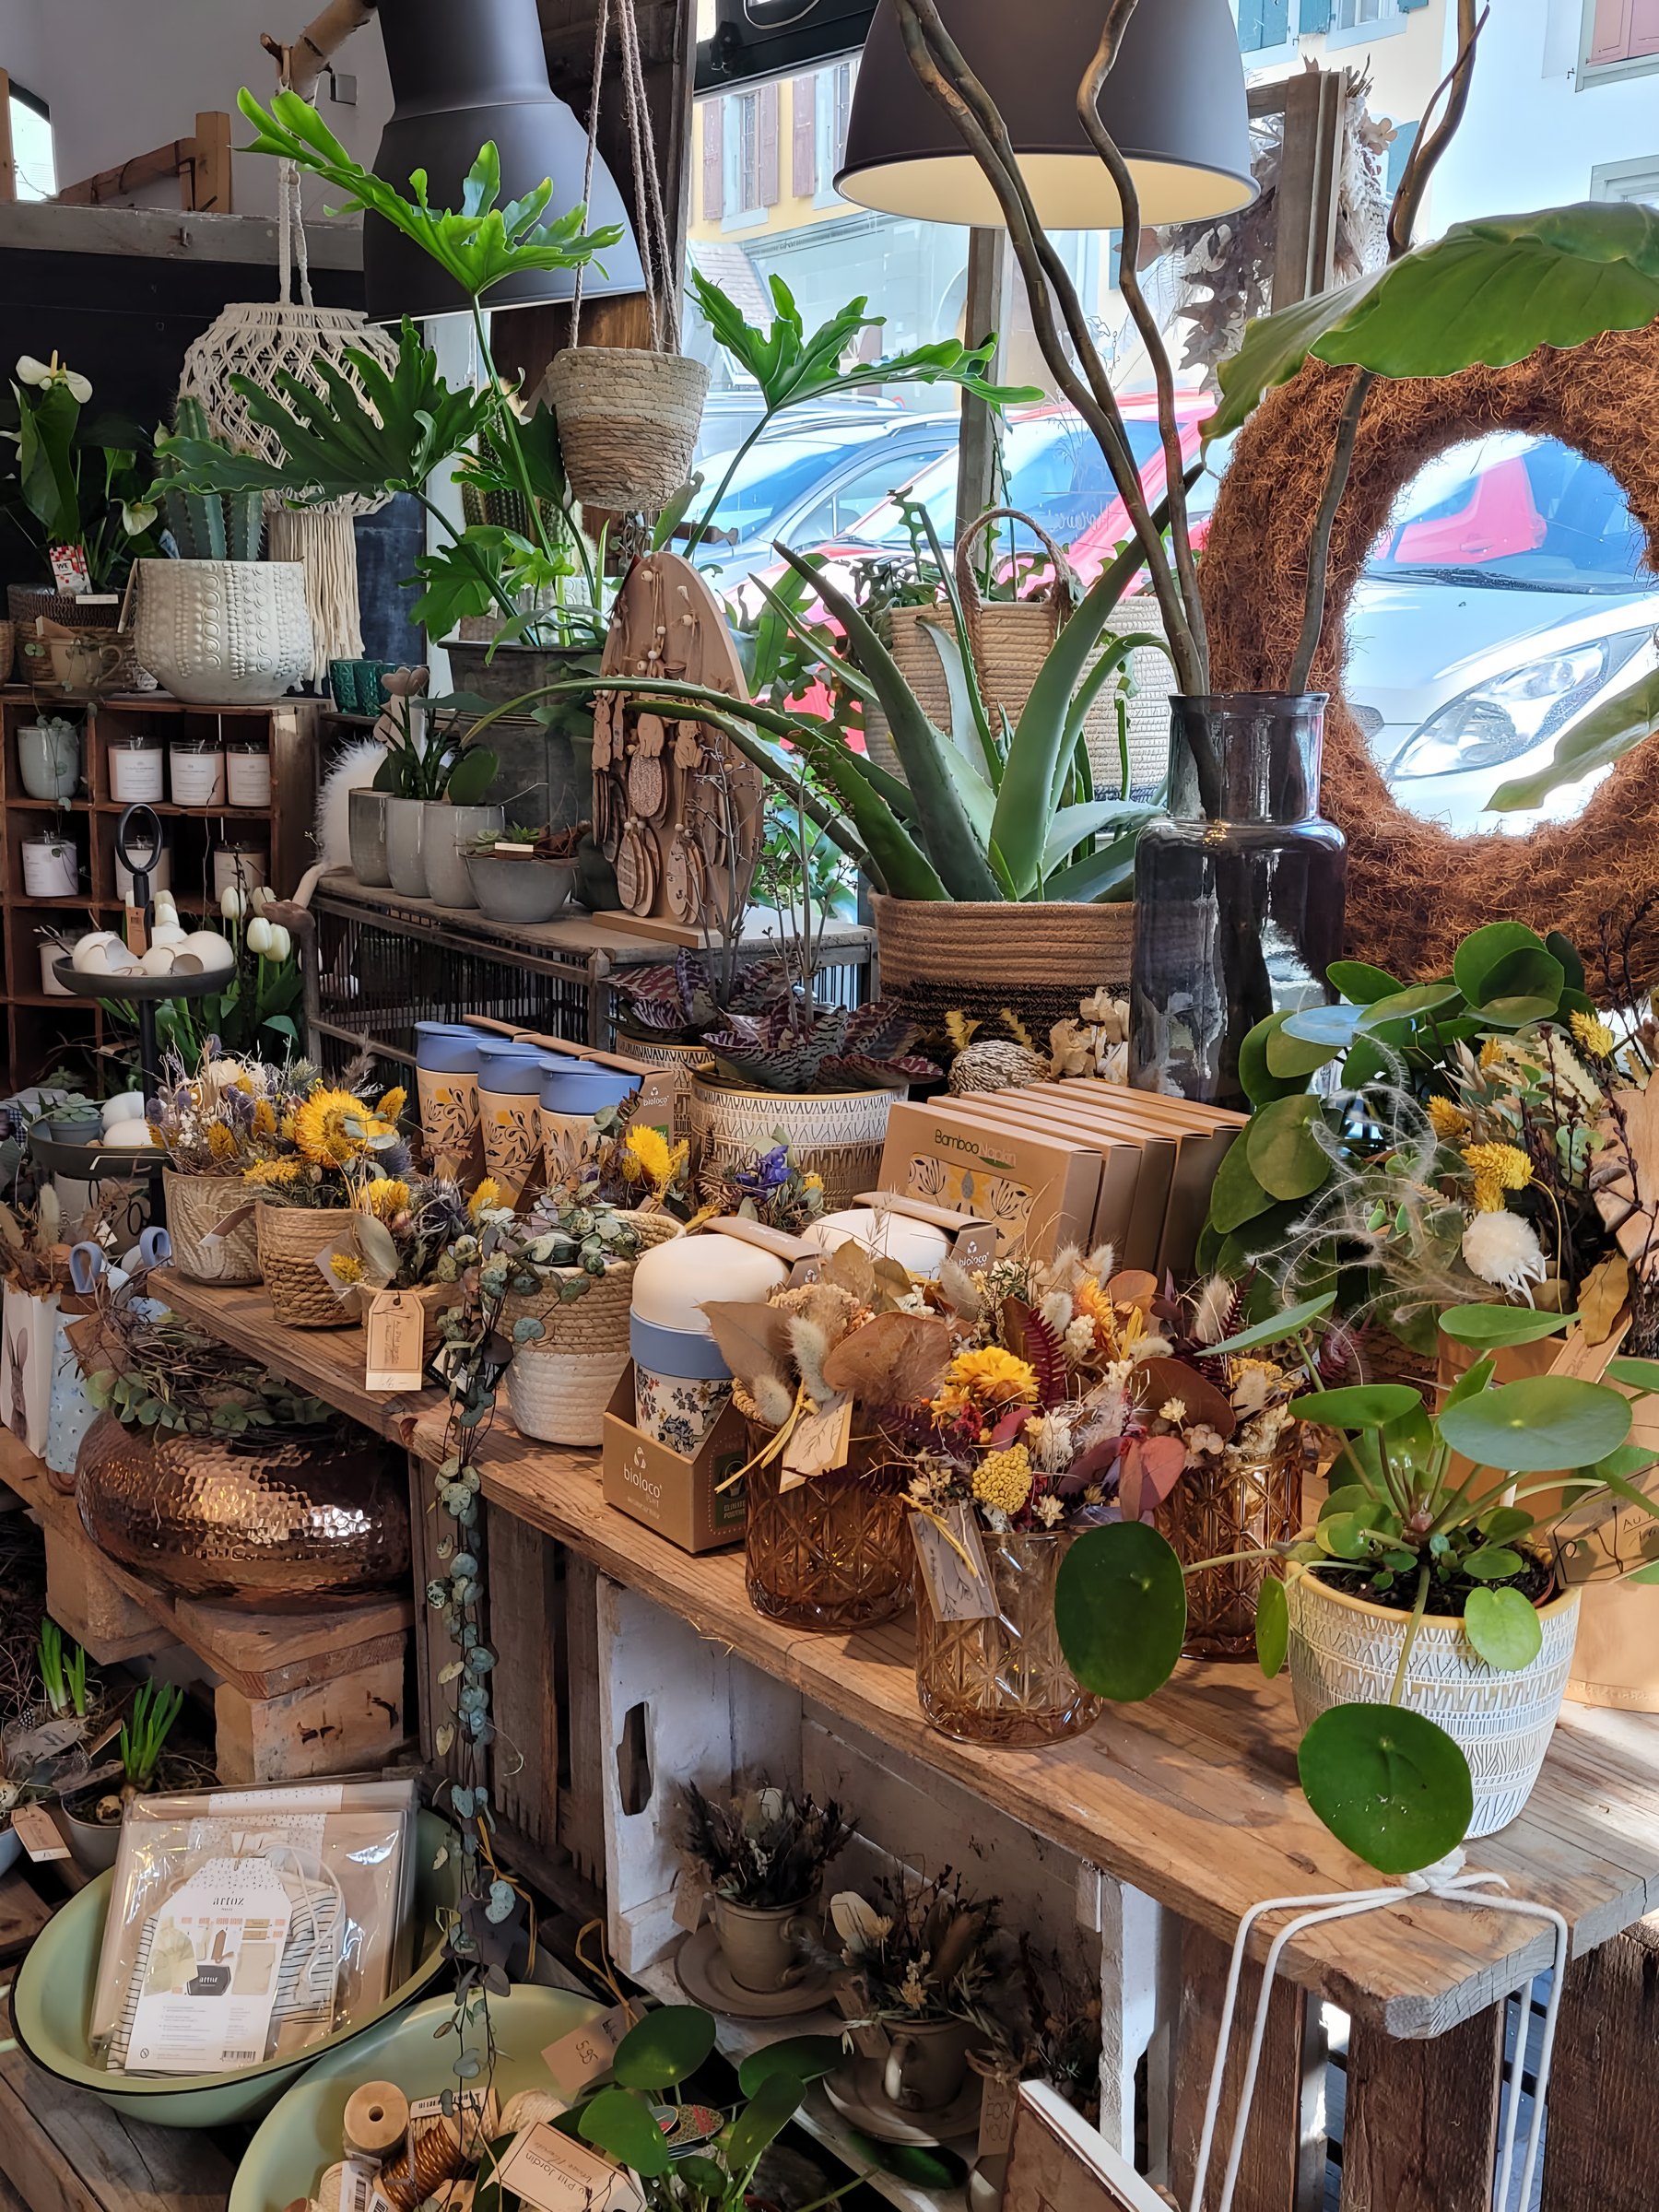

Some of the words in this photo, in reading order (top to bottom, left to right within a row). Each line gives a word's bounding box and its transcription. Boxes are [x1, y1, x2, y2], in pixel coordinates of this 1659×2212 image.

[935, 1129, 980, 1154] Bamboo
[623, 1462, 661, 1499] bioloco
[525, 2152, 556, 2177] Jardin
